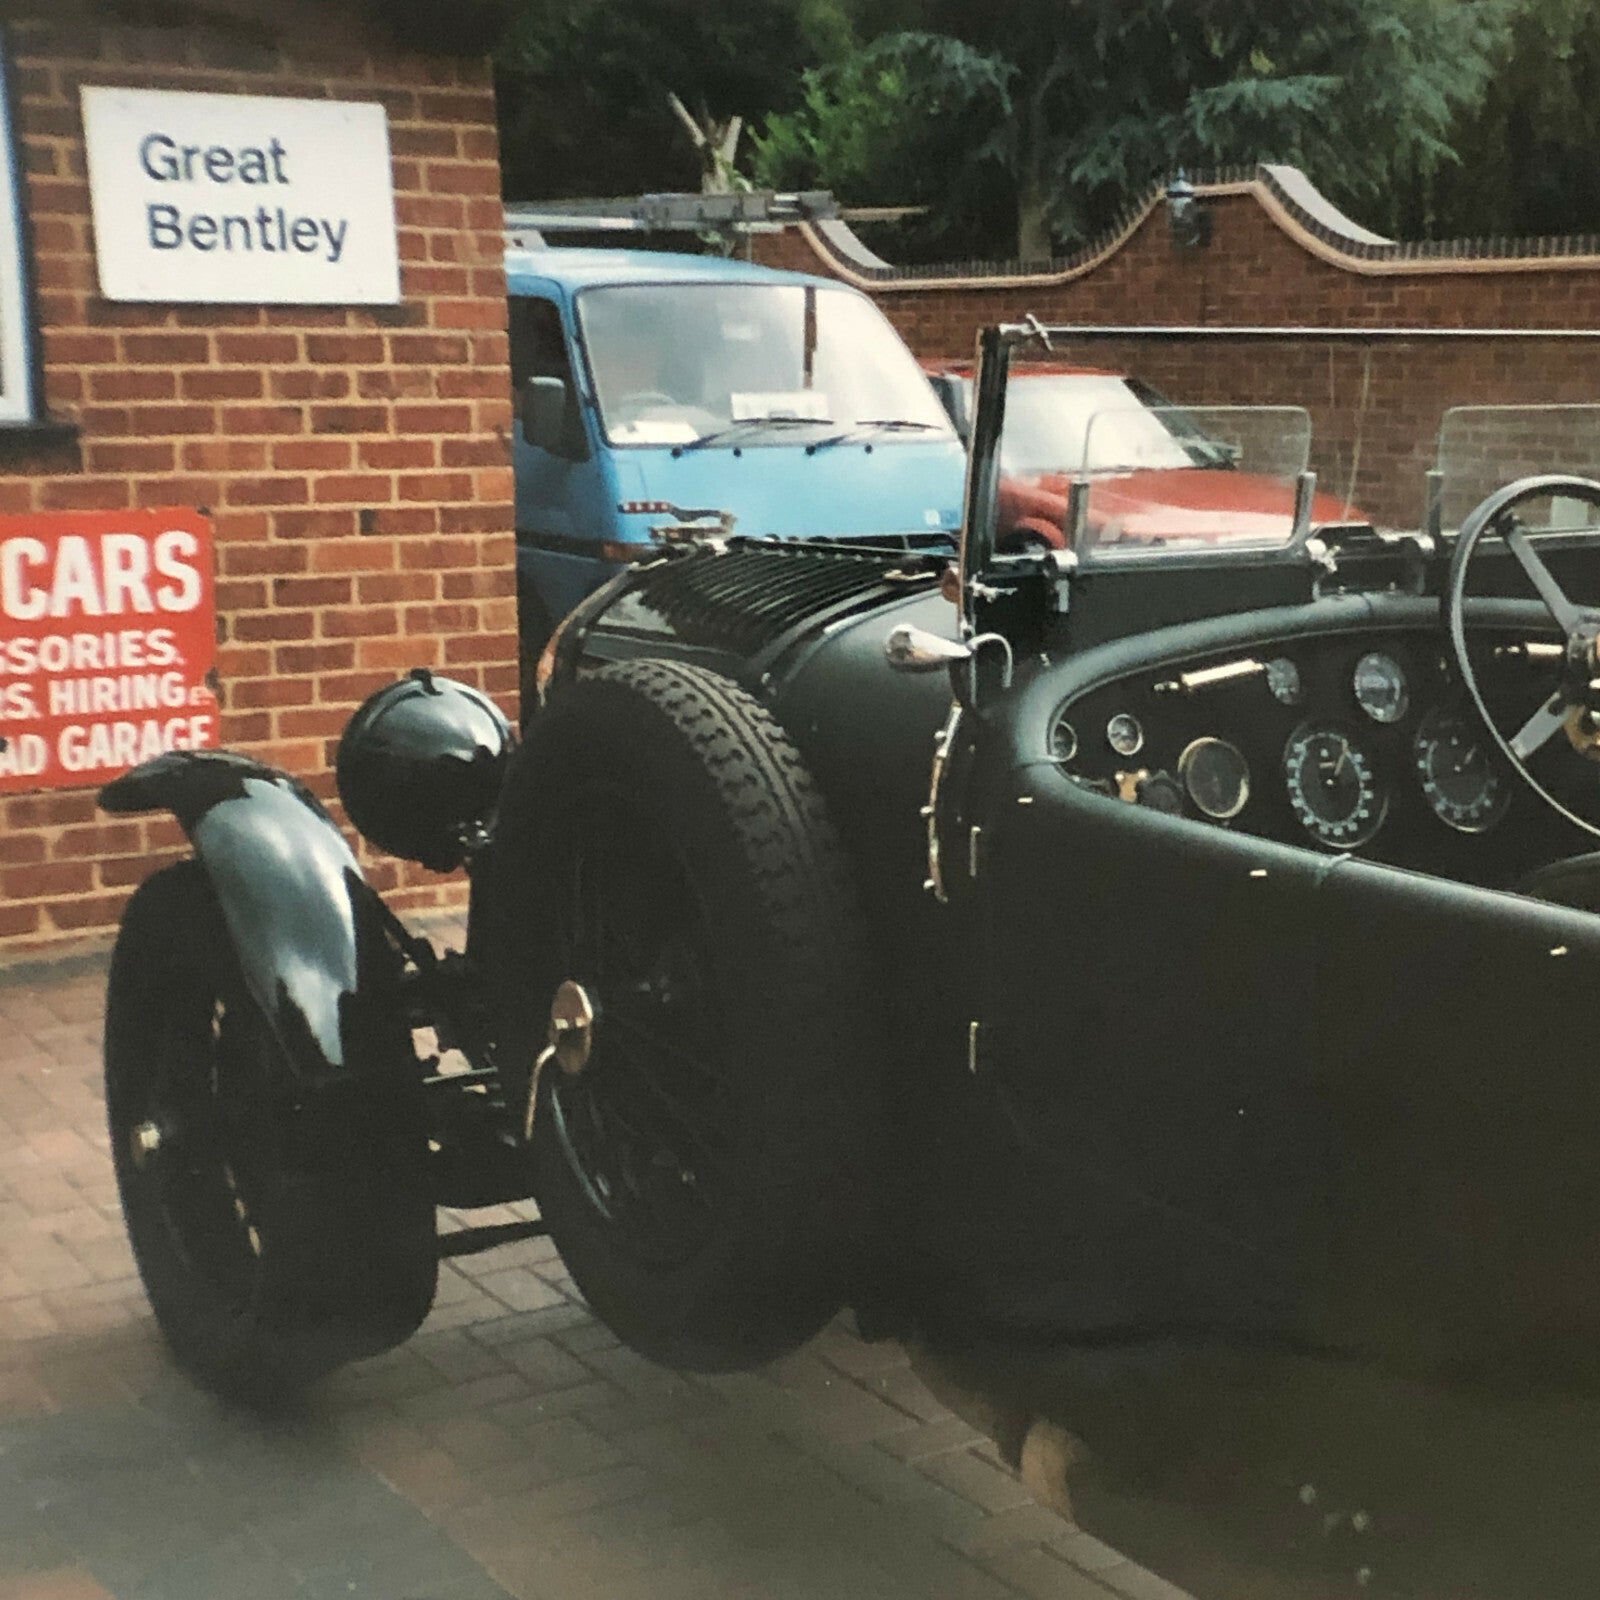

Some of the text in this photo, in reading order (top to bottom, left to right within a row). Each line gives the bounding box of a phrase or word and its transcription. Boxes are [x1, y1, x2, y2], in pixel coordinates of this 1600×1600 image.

[140, 132, 290, 185] Great
[147, 204, 348, 262] Bentley
[0, 531, 201, 620] CARS
[58, 715, 213, 771] GARAGE
